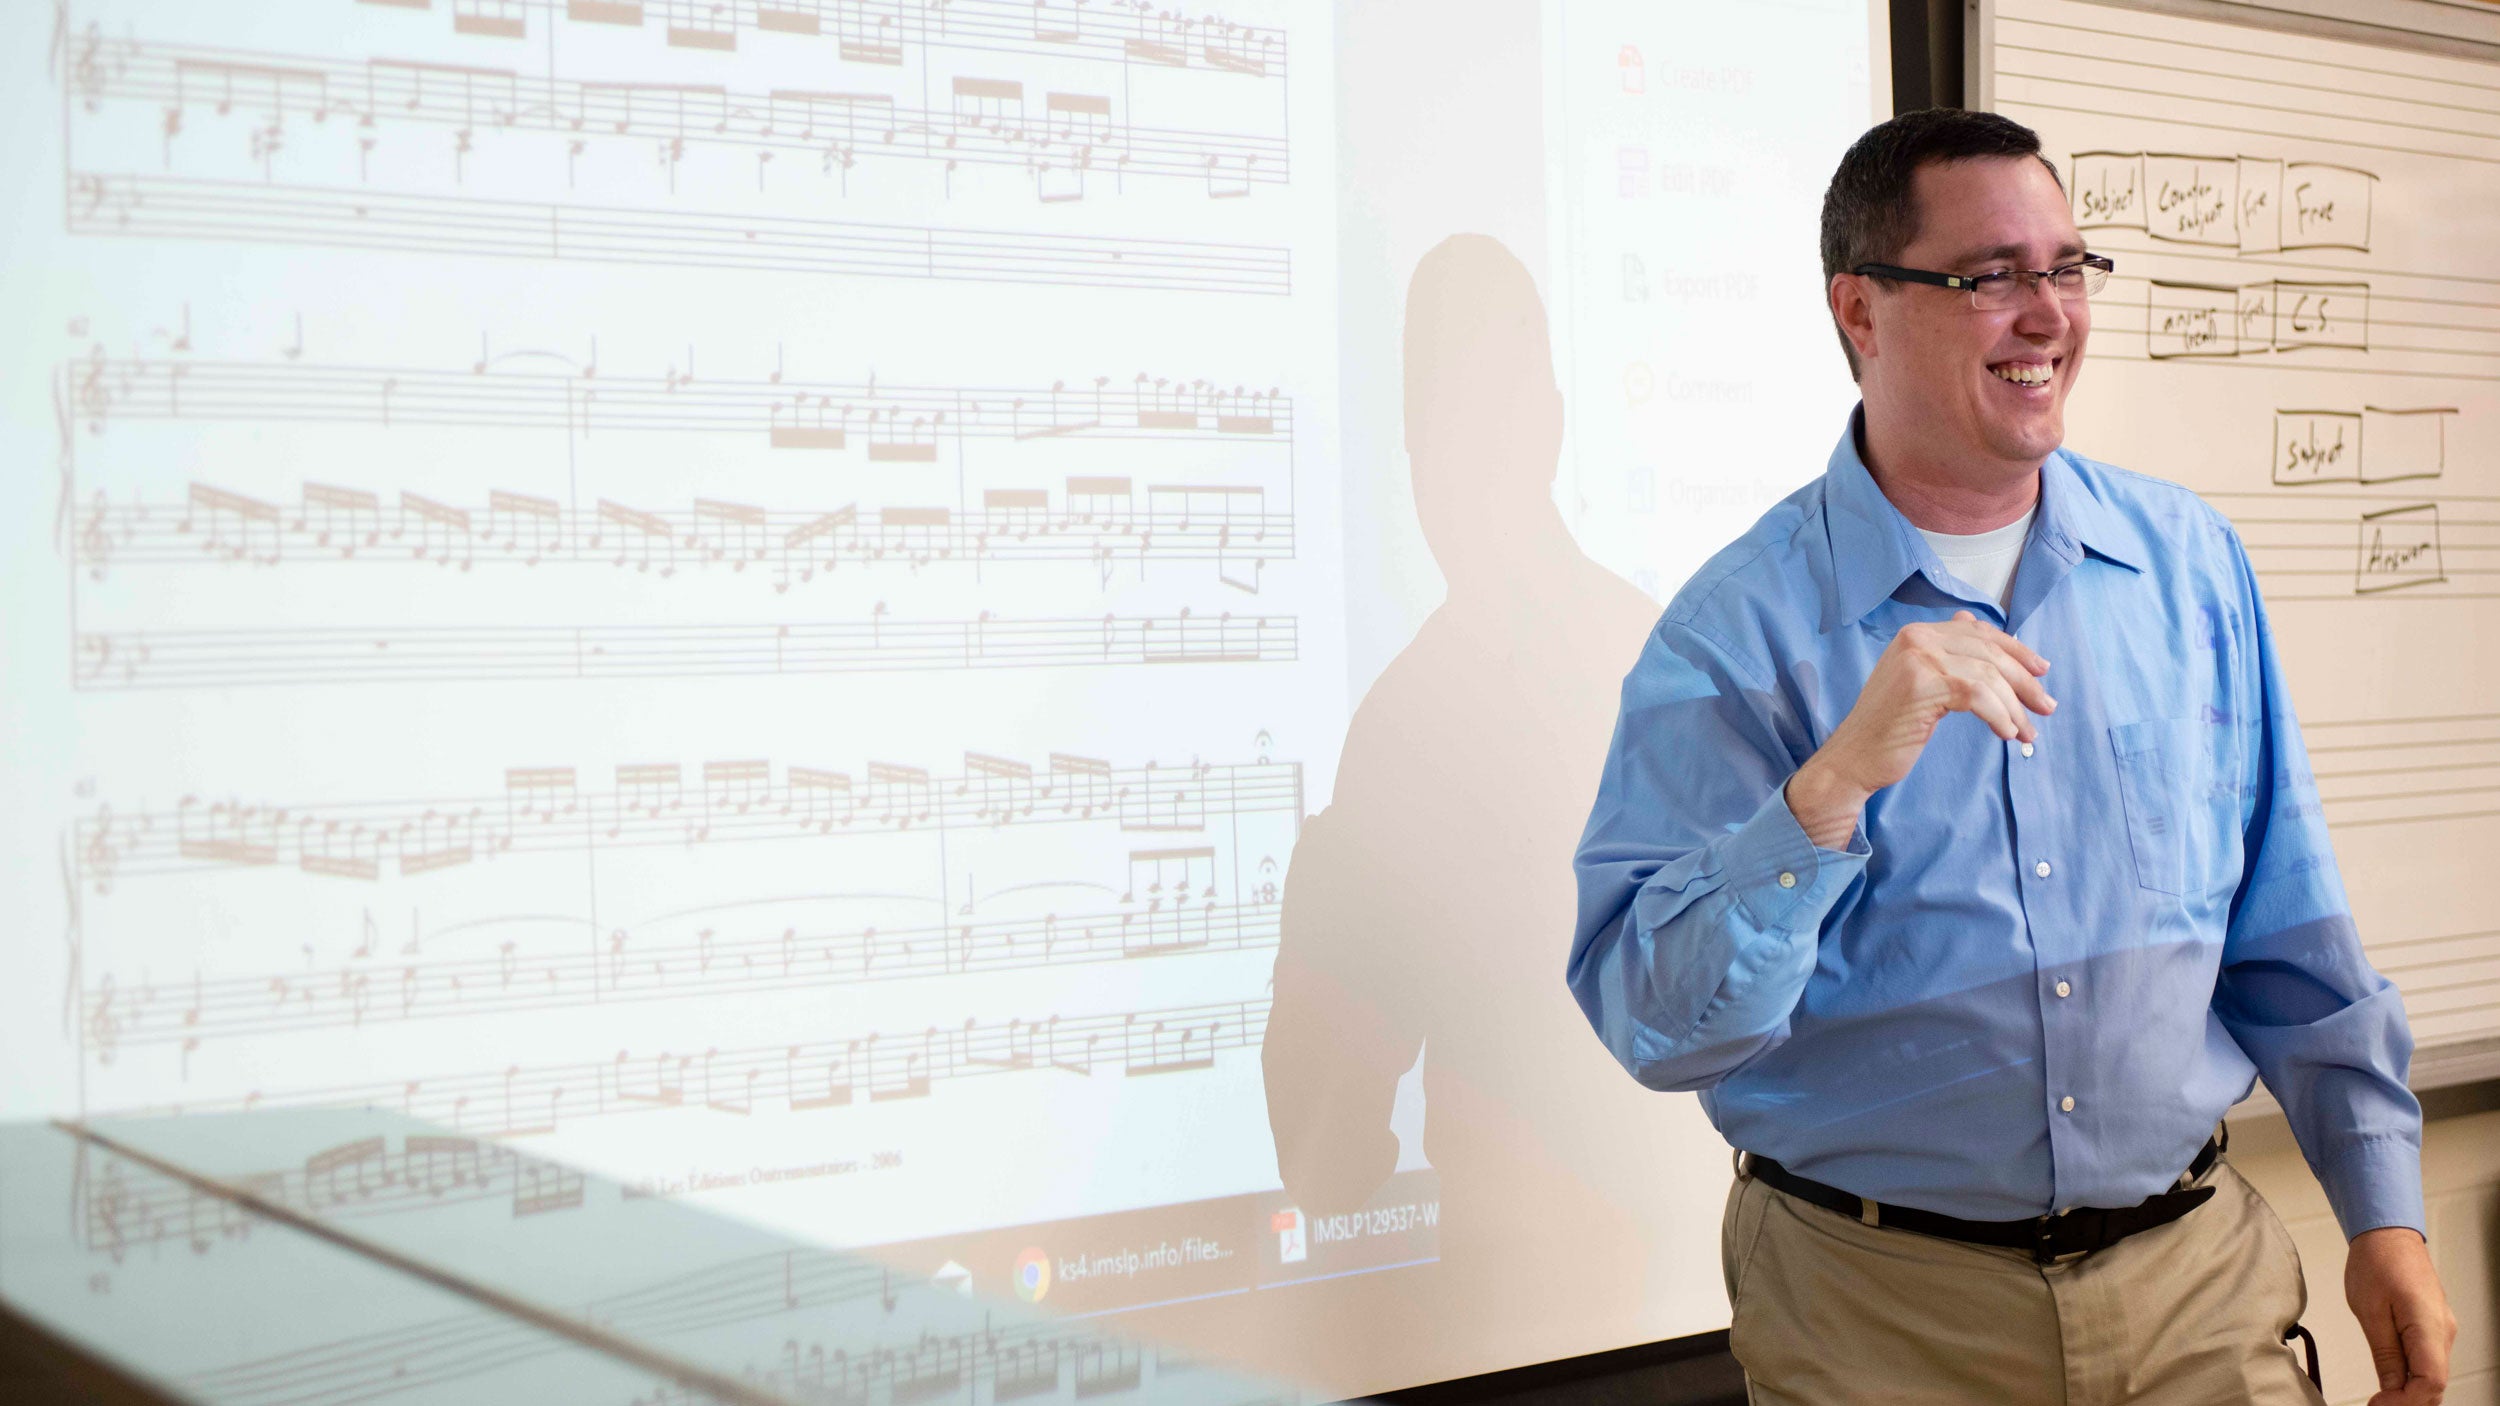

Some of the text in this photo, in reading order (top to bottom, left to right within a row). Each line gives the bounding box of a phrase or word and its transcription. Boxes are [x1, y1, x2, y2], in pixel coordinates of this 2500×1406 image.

[1659, 59, 1754, 96] Create PDF
[1662, 163, 1737, 200] Edit PDF
[1663, 267, 1760, 305] Export PDF
[1666, 370, 1753, 405] Comment
[1313, 1202, 1440, 1244] IMSLP129537-W
